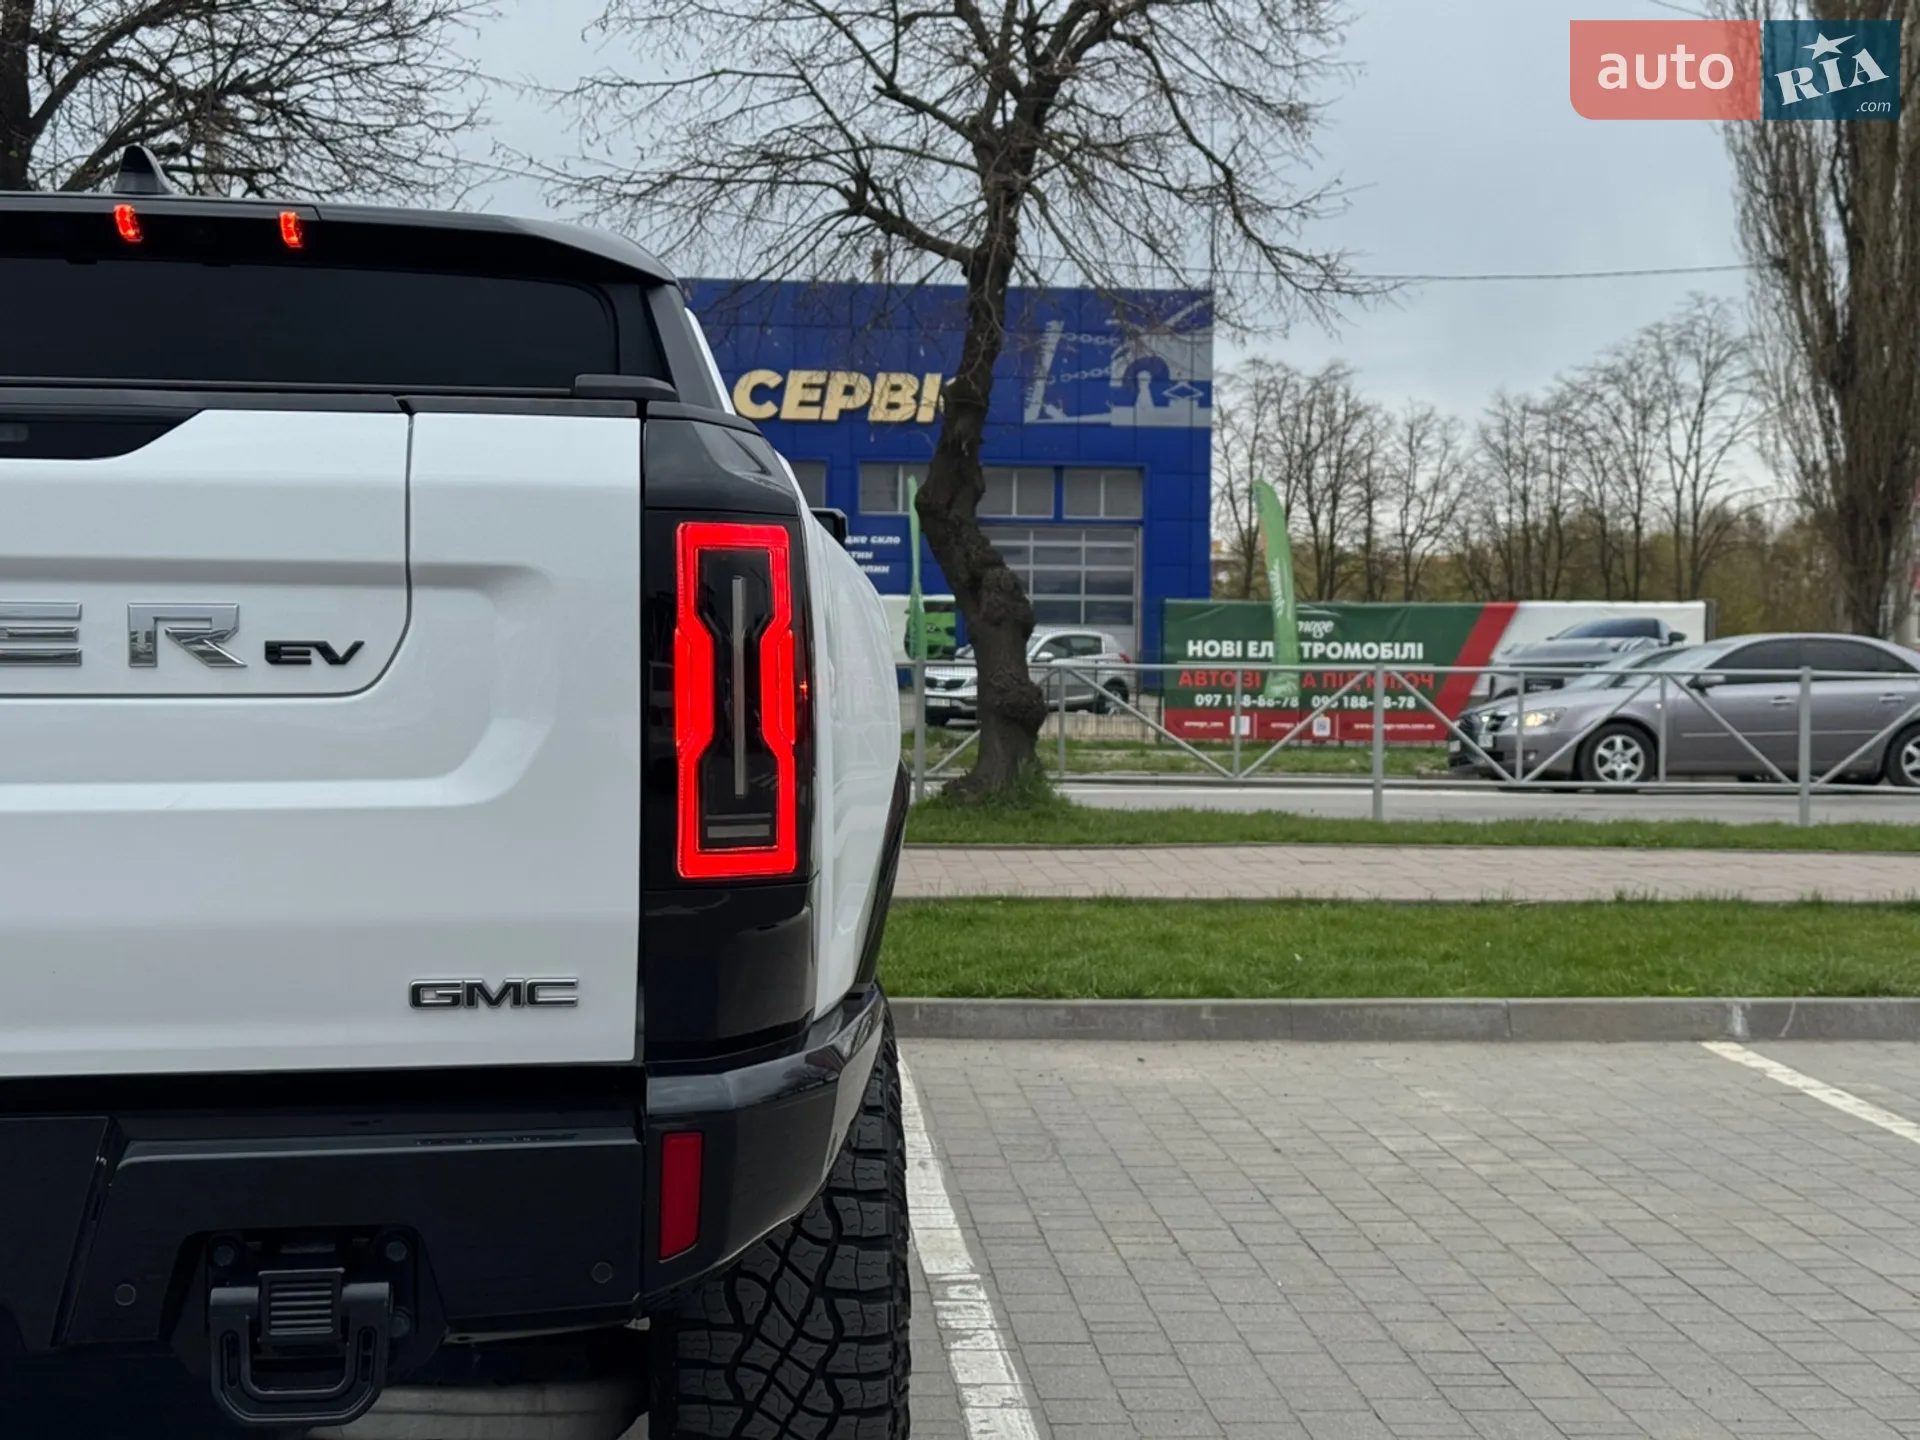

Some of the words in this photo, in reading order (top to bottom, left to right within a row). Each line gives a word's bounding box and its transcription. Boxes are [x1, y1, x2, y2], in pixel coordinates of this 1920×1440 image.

[733, 369, 945, 422] СЕРВІ
[264, 640, 364, 665] EV
[1187, 640, 1242, 657] НОВІ
[1247, 641, 1424, 660] ЕЛТРОМОБІЛІ
[1179, 669, 1237, 688] АВТО
[1243, 670, 1261, 688] ЗІ
[1195, 694, 1221, 707] 097
[1226, 694, 1300, 708] 18-88-78
[1342, 695, 1416, 709] 188-8-78
[409, 977, 578, 1009] GMC
